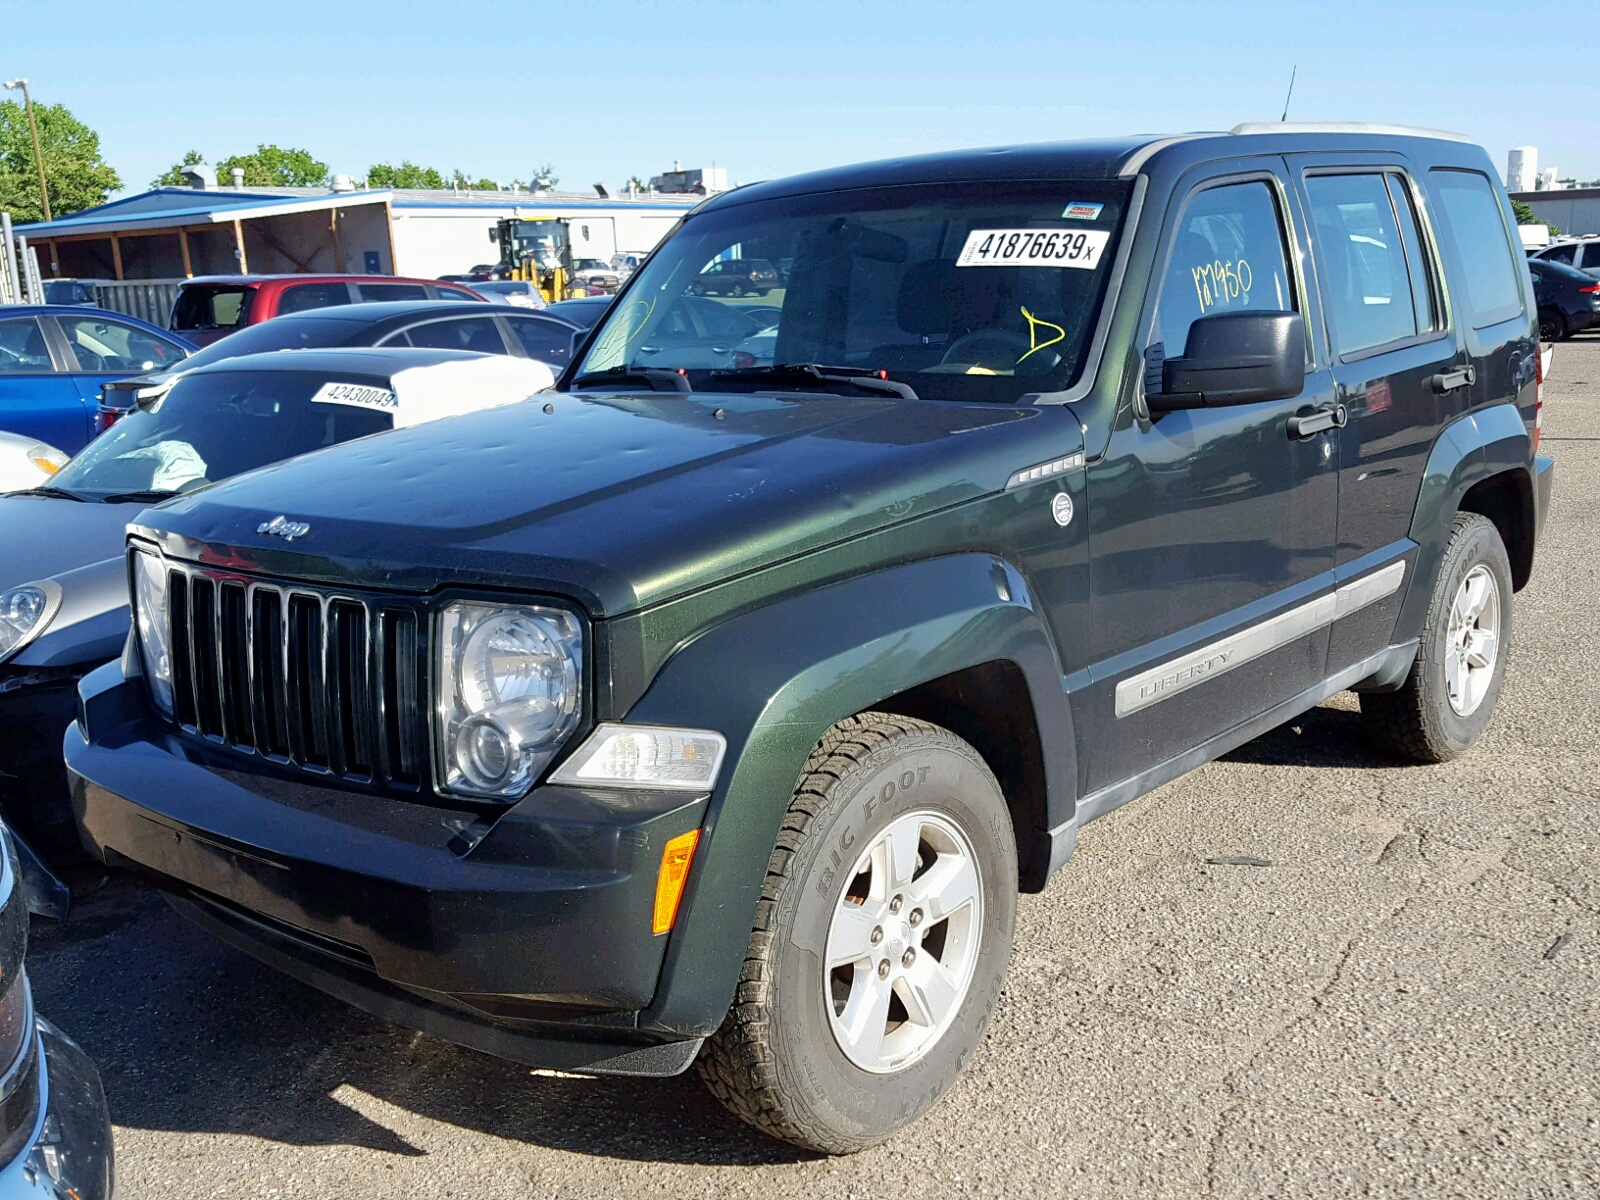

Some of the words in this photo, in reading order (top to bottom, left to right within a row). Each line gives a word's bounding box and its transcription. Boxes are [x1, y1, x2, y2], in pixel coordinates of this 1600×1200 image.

[257, 515, 310, 541] Jeep
[1140, 648, 1234, 700] LIBERTY
[815, 825, 856, 899] BIG
[863, 765, 931, 822] FOOT
